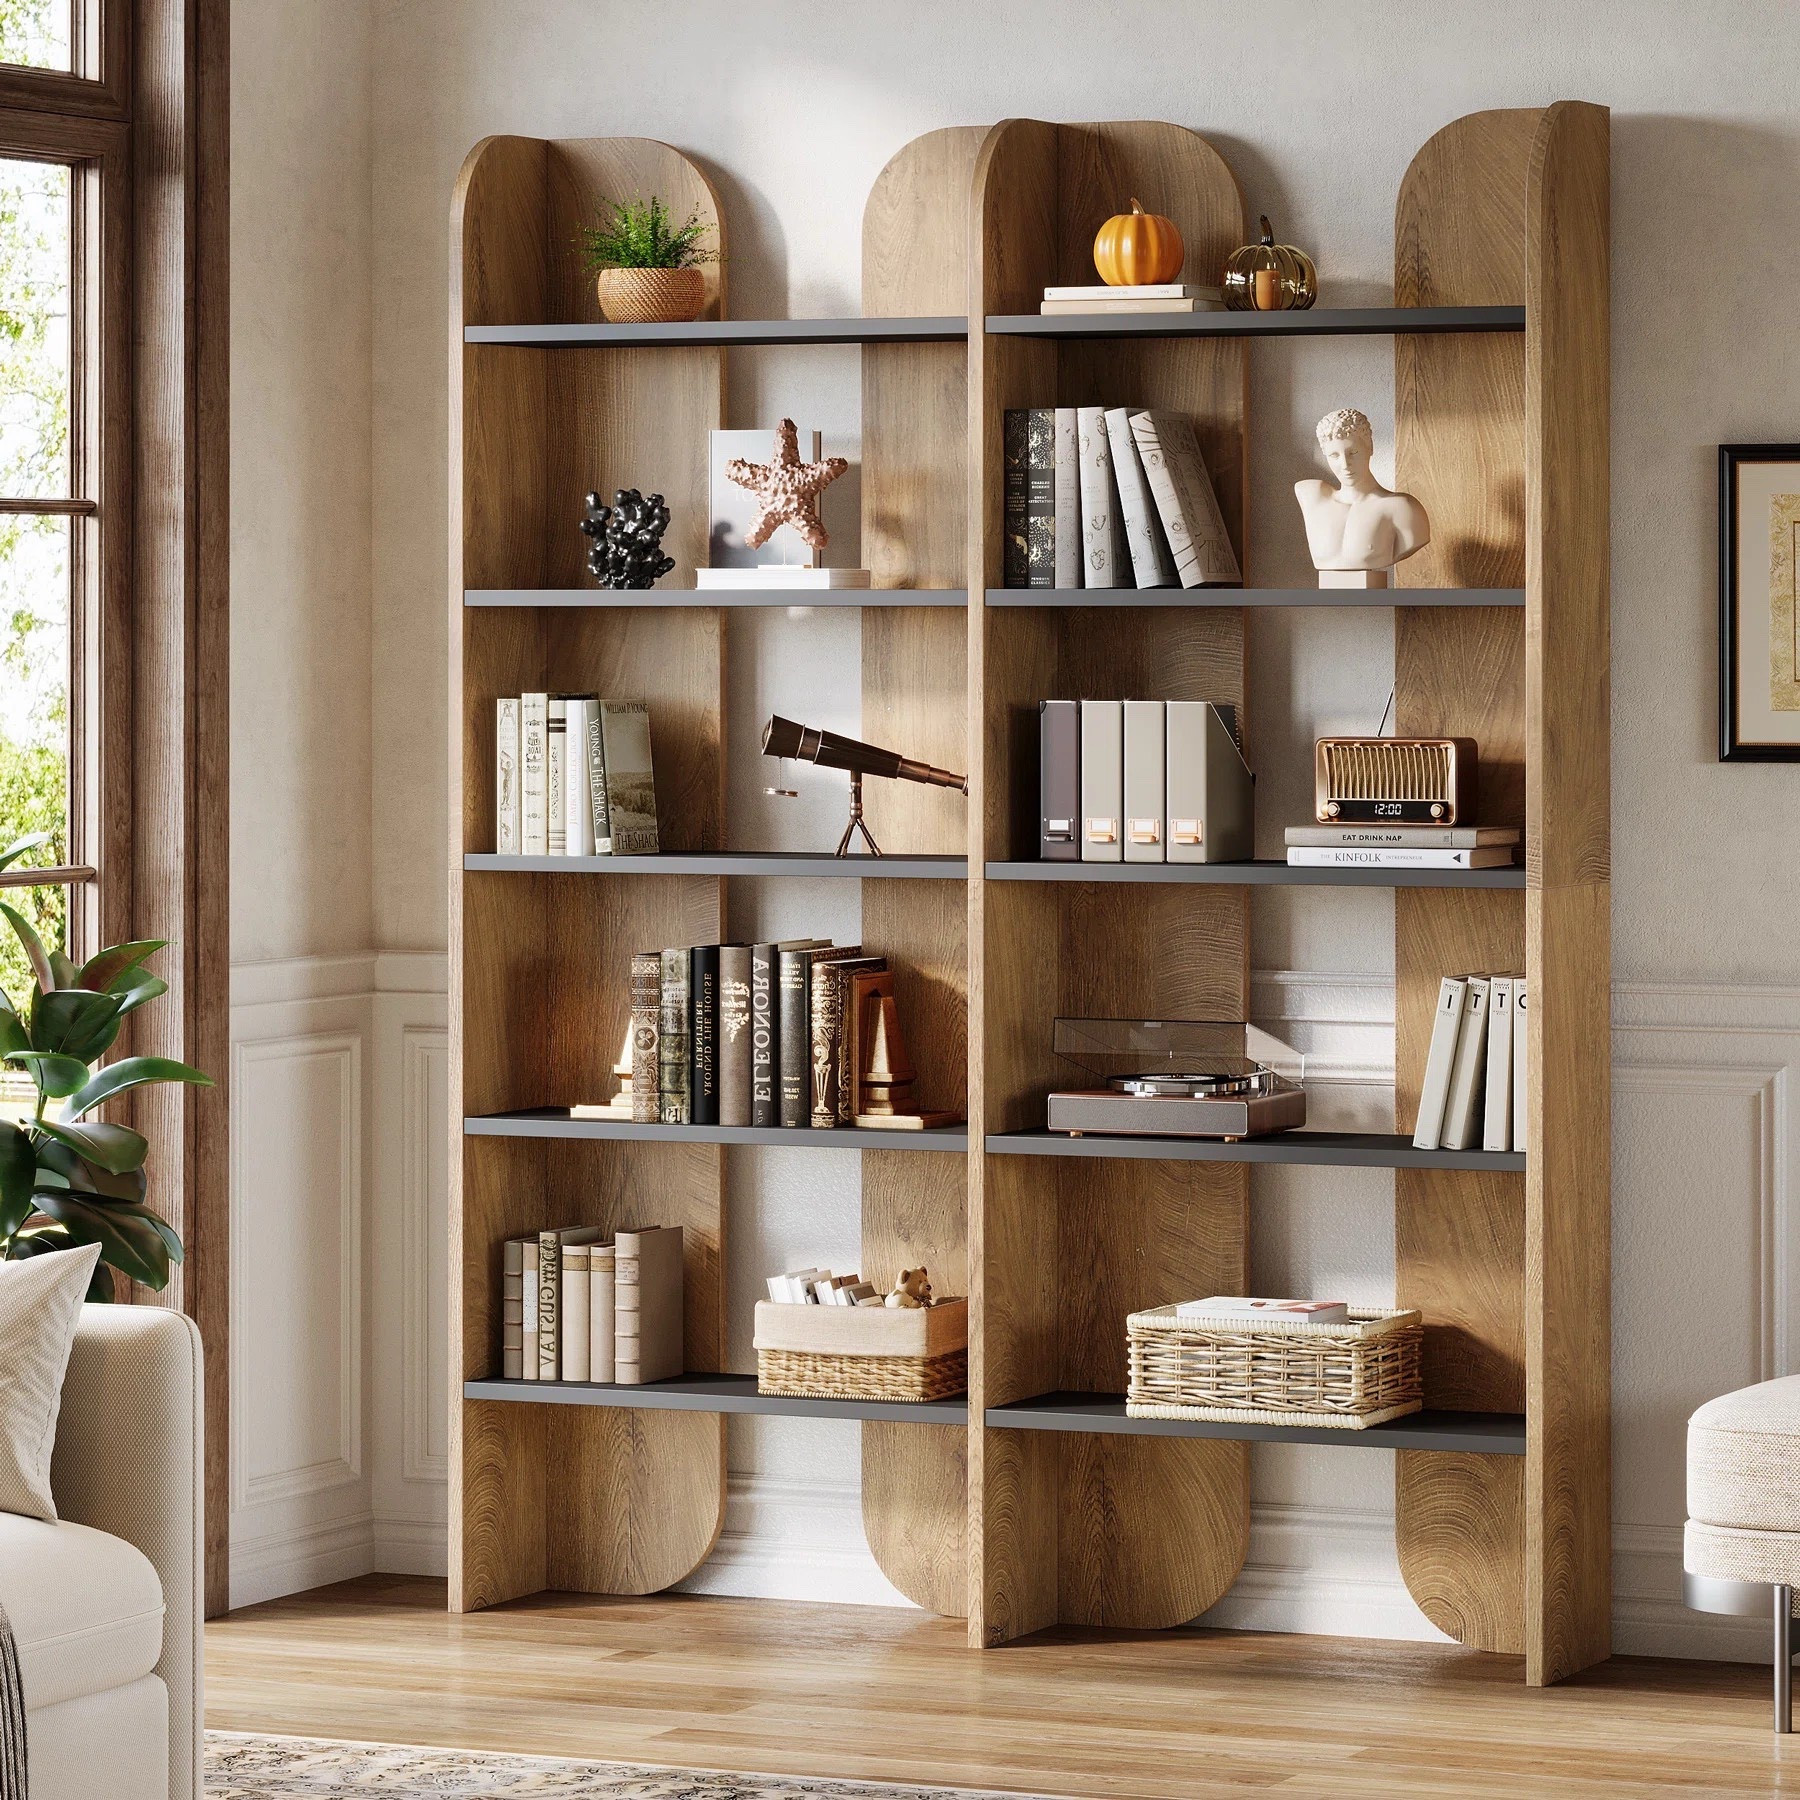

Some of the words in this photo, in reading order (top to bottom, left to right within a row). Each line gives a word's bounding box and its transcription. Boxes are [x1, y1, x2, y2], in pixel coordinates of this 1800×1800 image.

[605, 703, 626, 714] WILLIAM
[631, 703, 648, 713] YOUNG
[589, 718, 601, 757] YOUNG
[592, 767, 604, 788] THE
[593, 791, 607, 825] SHACK
[1374, 803, 1402, 815] 12:00
[615, 833, 632, 849] THE
[1335, 852, 1382, 863] KINFOLK
[1473, 993, 1481, 1008] T
[1497, 993, 1506, 1008] T
